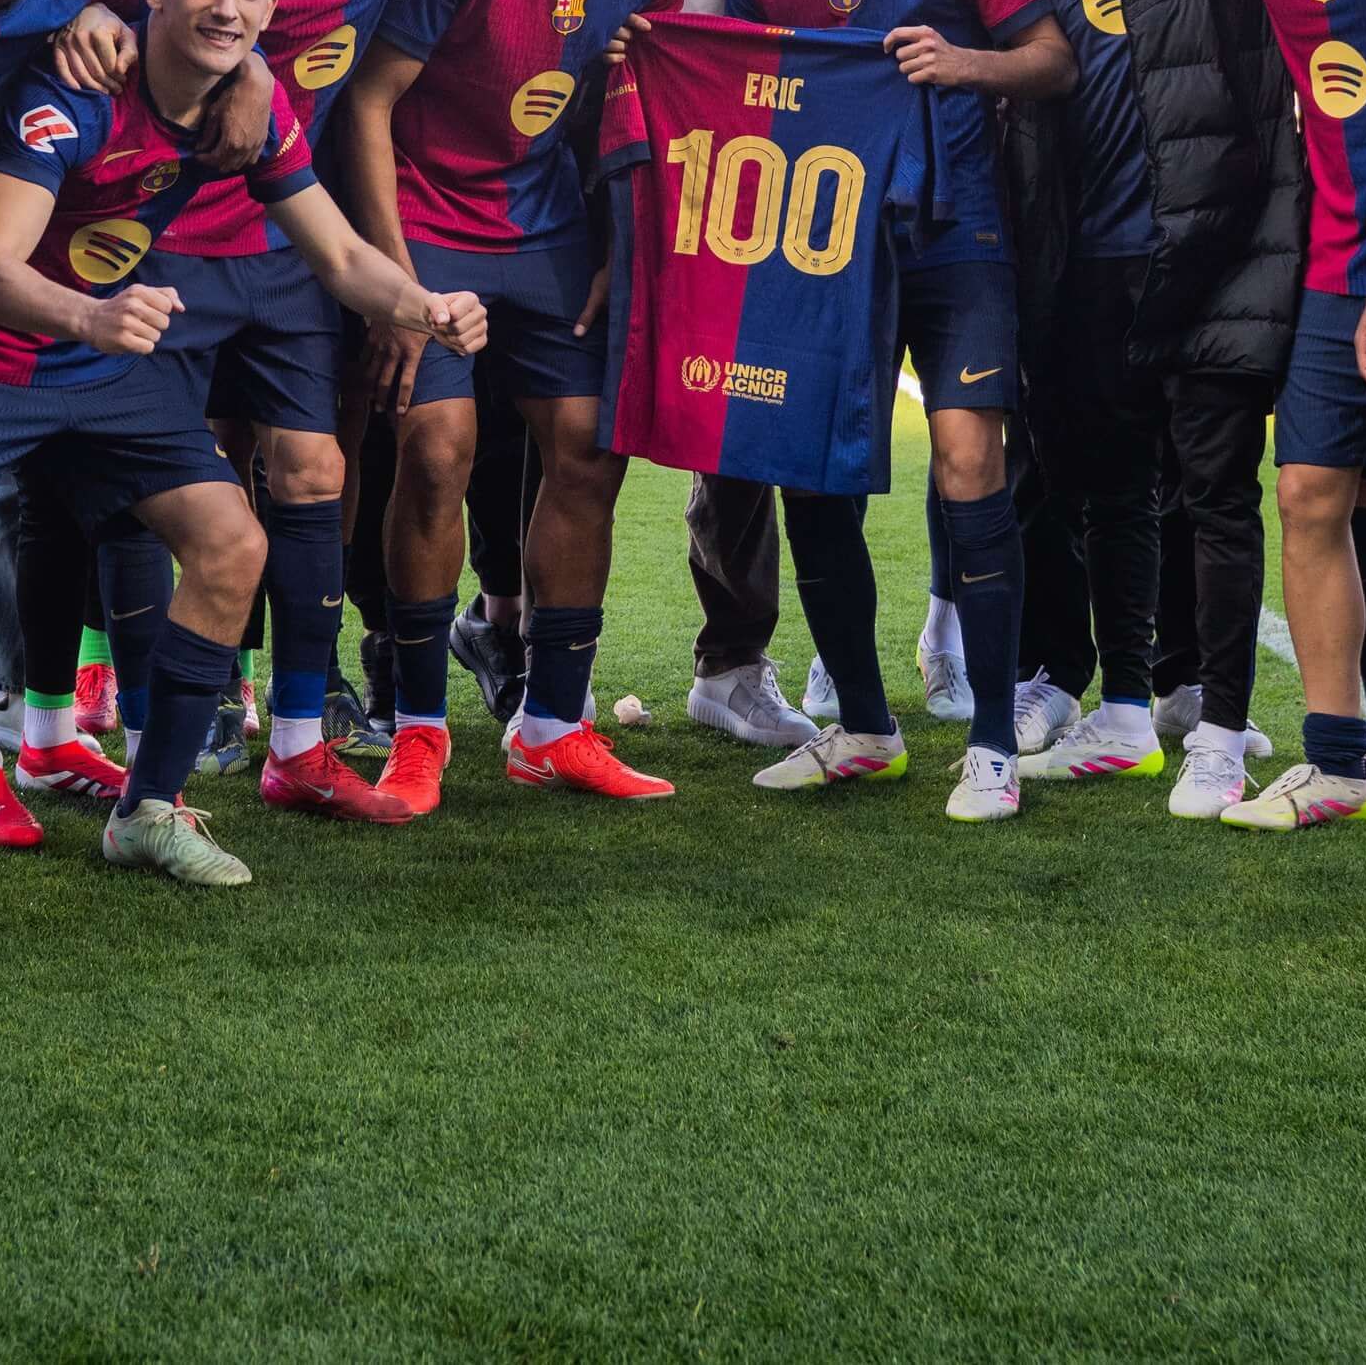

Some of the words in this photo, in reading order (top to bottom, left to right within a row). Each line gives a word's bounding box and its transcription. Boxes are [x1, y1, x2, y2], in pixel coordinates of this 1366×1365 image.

[744, 72, 805, 113] ERIC
[667, 129, 866, 276] 100
[721, 376, 787, 400] ACNUR
[724, 361, 788, 386] UNHCR
